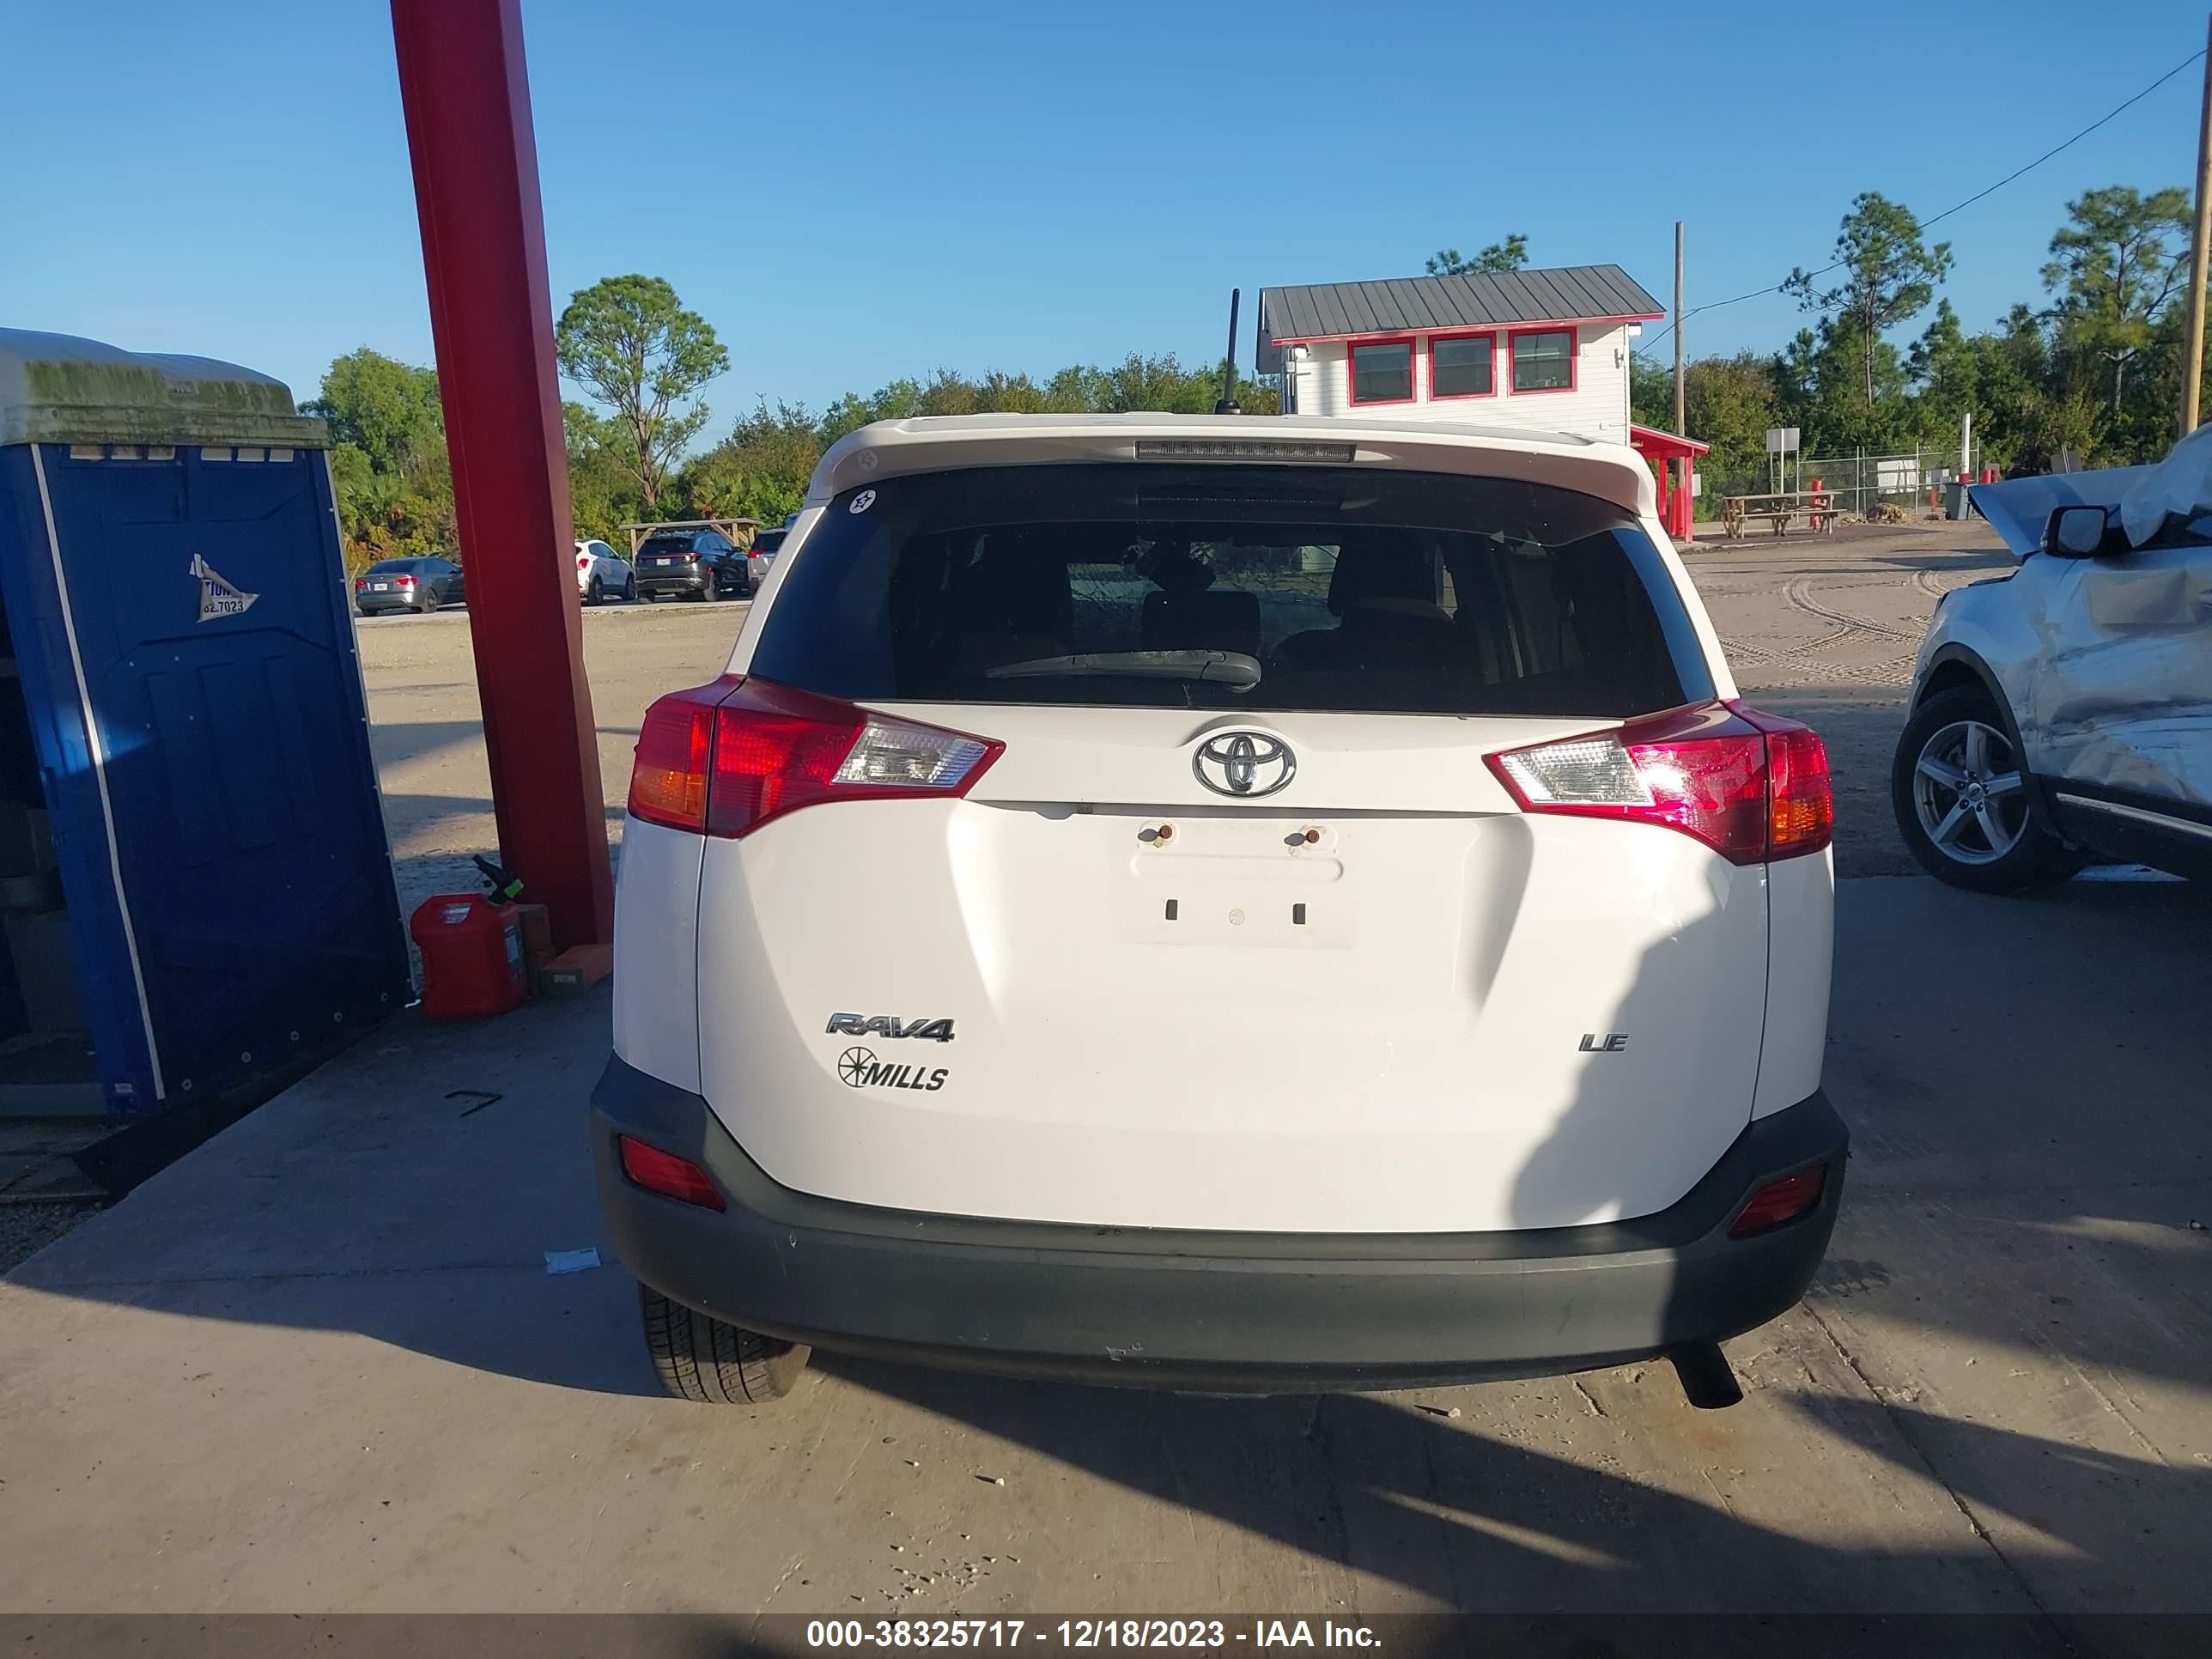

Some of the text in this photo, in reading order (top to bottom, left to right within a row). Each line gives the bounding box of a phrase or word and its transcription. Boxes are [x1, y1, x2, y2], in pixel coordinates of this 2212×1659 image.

[825, 1012, 955, 1042] RAV4
[1578, 1033, 1629, 1052] LE
[862, 1062, 950, 1091] MILLS
